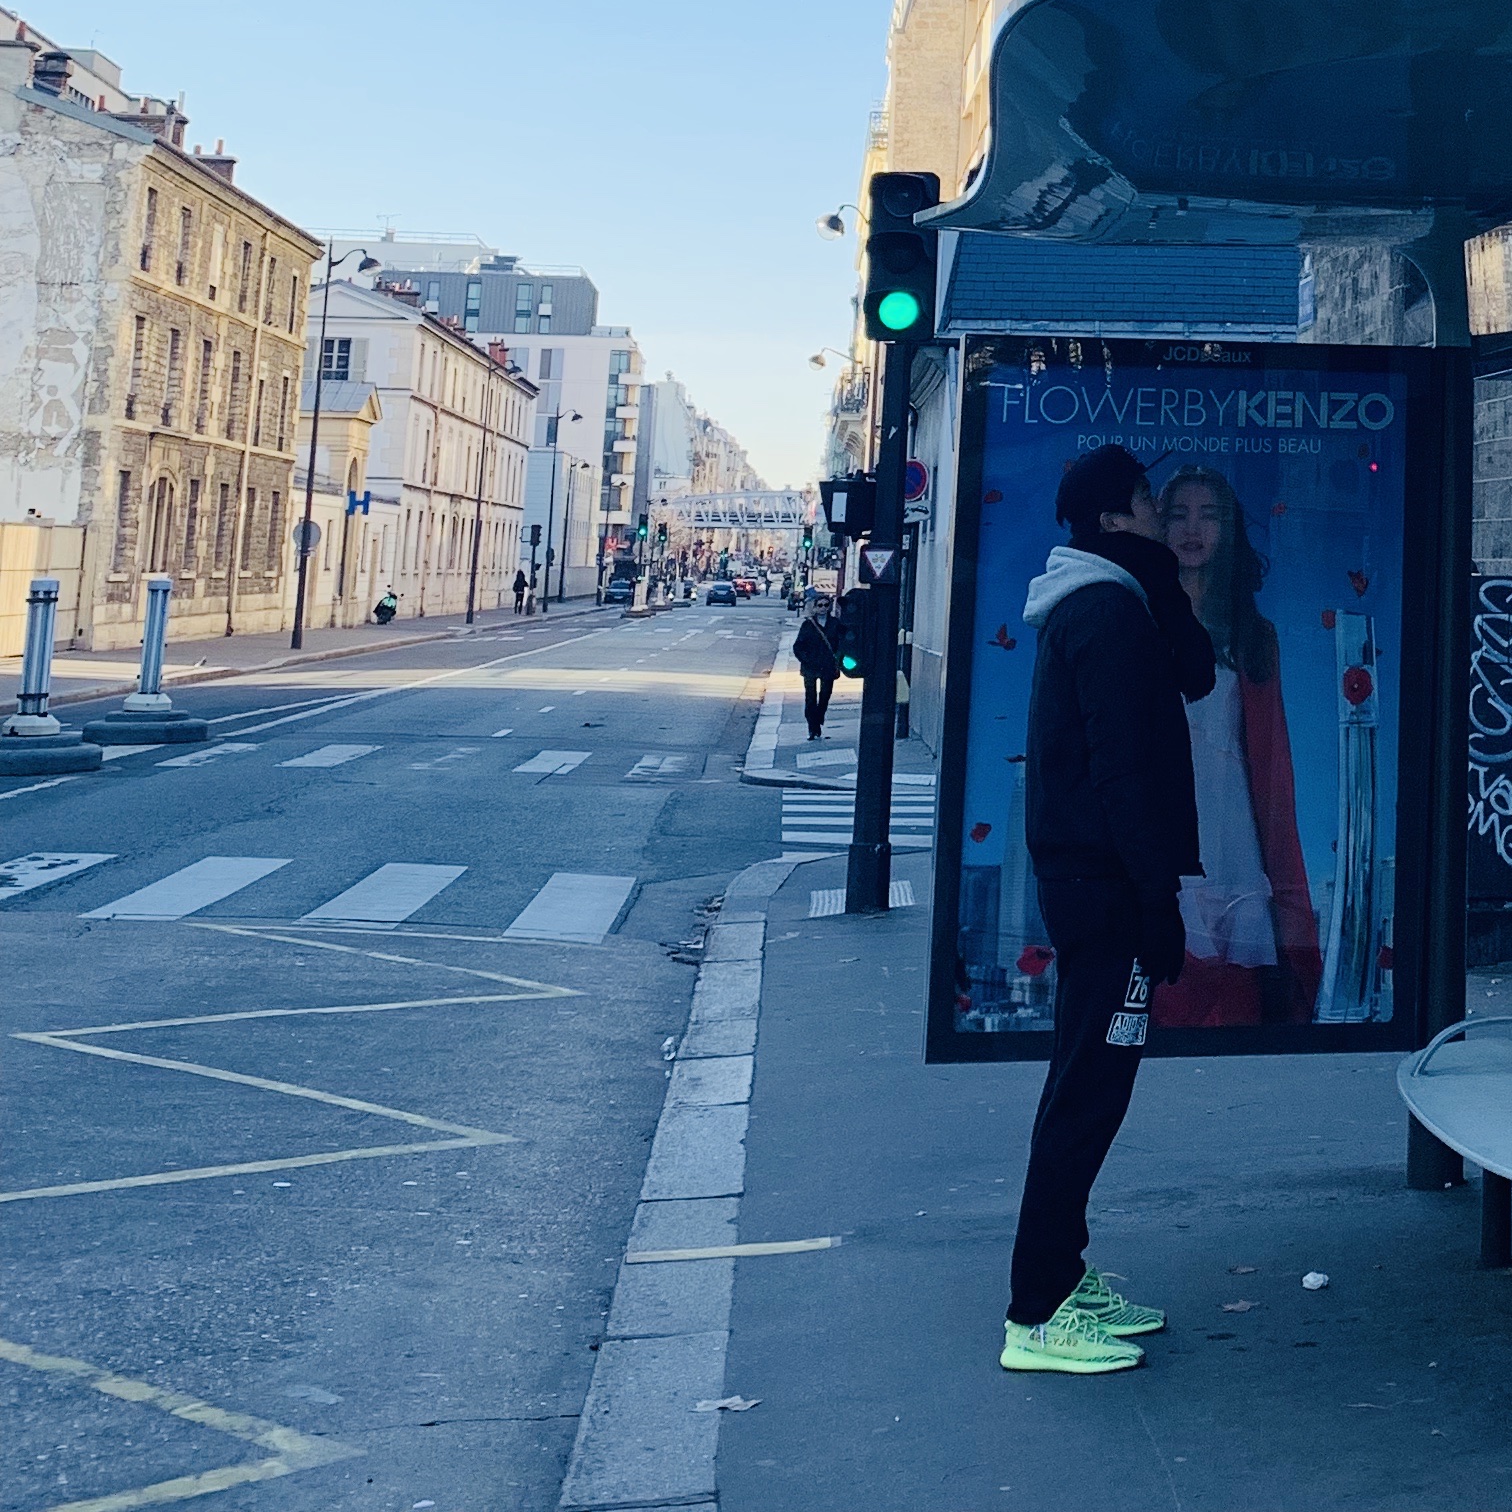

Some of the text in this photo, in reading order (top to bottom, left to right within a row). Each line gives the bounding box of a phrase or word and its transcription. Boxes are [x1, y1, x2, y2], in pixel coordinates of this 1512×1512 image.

[1077, 434, 1323, 455] POUR UN MONDE PLUS BEAU
[348, 490, 372, 516] H
[1130, 975, 1150, 1002] 76
